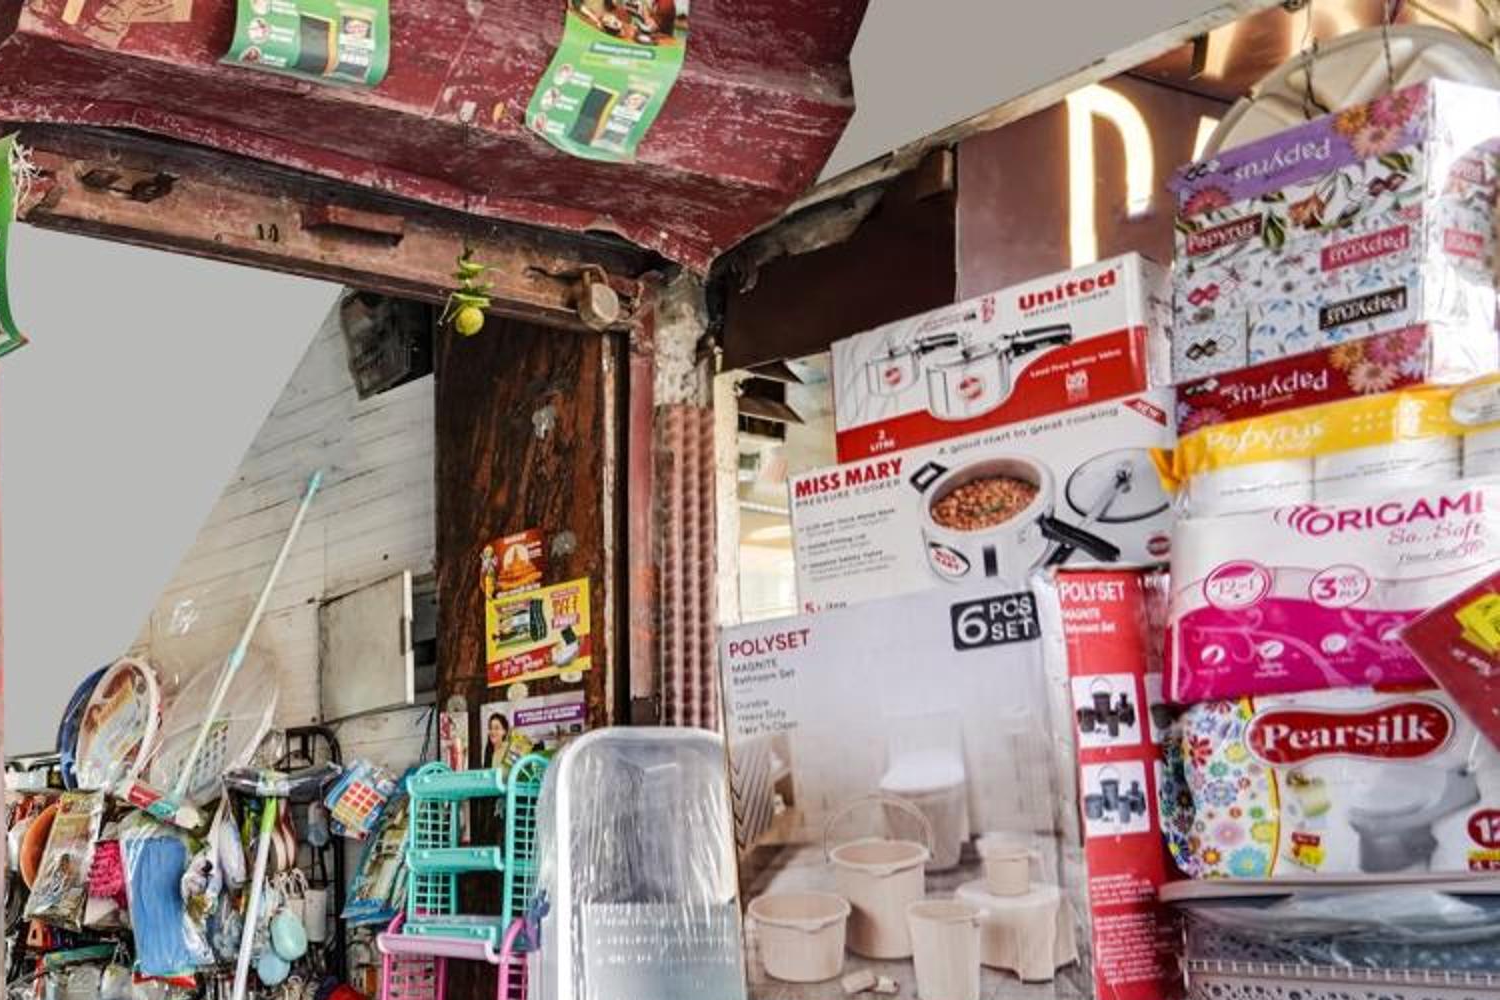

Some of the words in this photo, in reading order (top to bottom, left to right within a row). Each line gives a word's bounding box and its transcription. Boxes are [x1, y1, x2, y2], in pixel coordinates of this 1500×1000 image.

[1017, 268, 1117, 311] United
[795, 471, 841, 499] MISS
[845, 457, 903, 488] MARY
[1305, 491, 1484, 537] ORIGAMI
[1059, 580, 1125, 603] POLYSET
[1317, 577, 1338, 601] 3
[957, 605, 988, 645] 6
[989, 595, 1032, 620] PCS
[728, 628, 811, 659] POLYSET
[990, 617, 1033, 642] SET
[1263, 714, 1437, 756] Pearsilk
